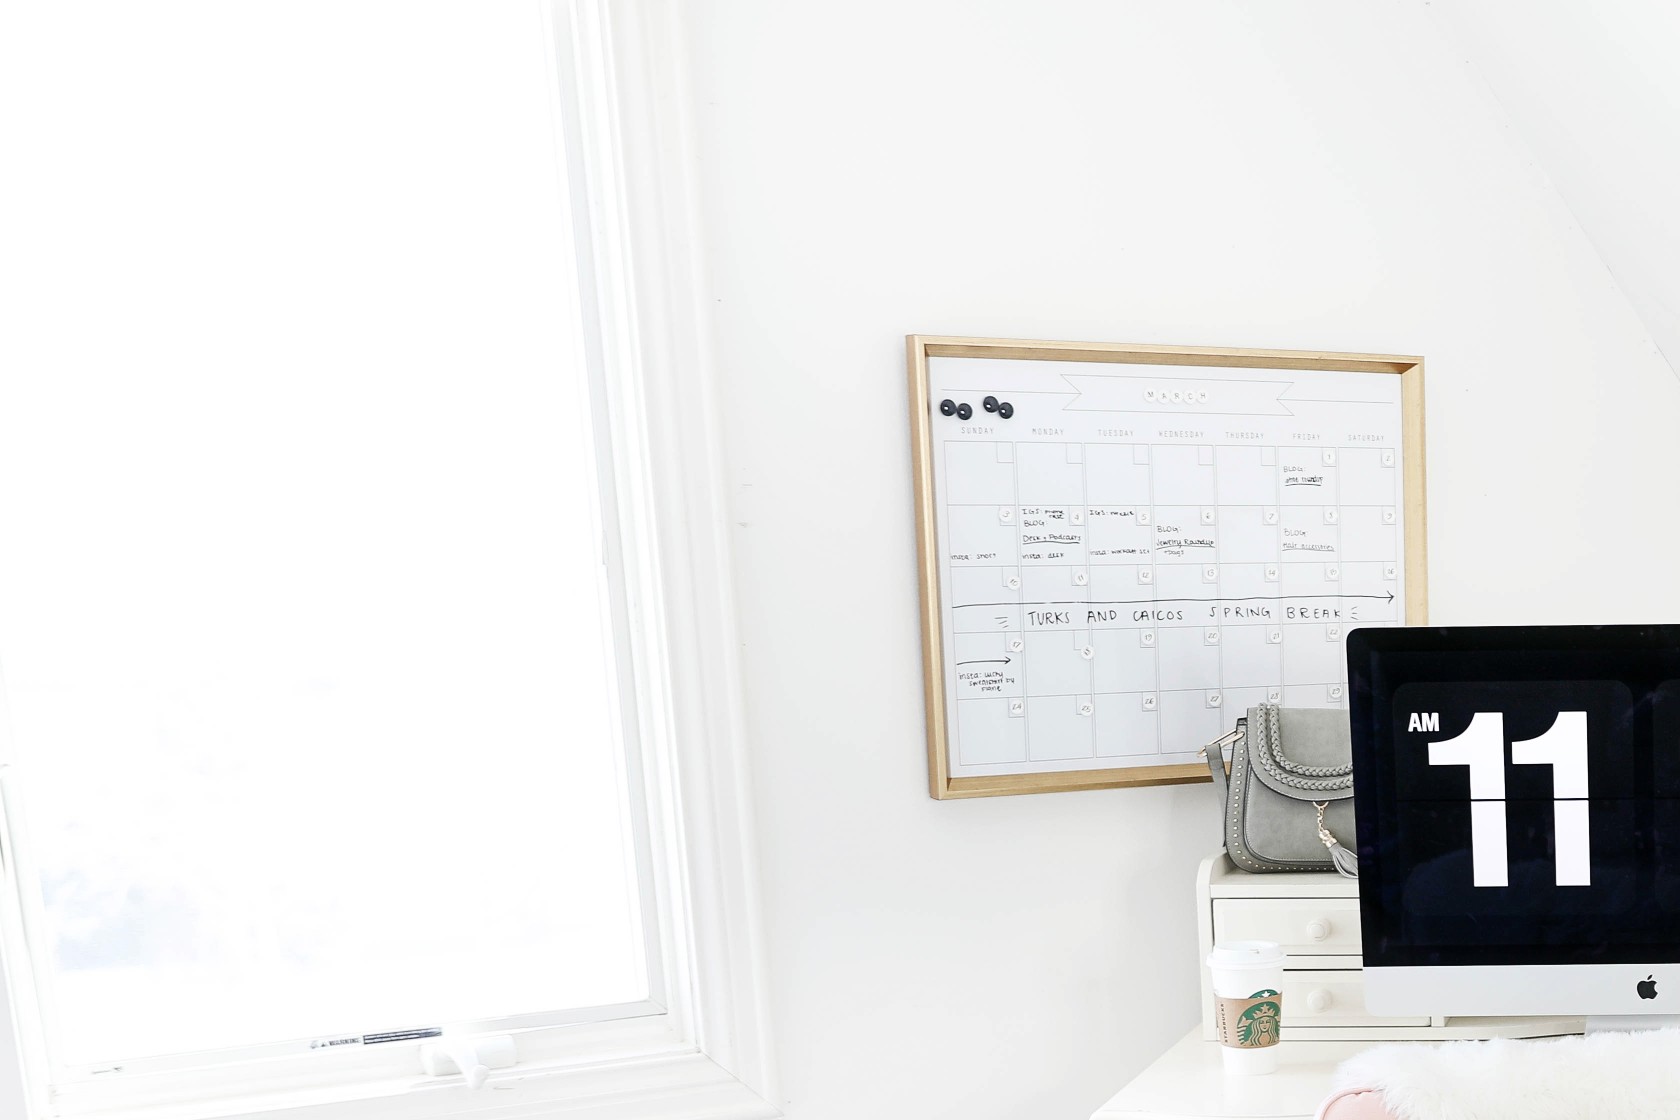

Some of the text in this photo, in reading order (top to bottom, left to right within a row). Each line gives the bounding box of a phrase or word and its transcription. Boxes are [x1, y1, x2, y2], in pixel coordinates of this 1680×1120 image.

[1147, 391, 1207, 400] MARCH
[961, 427, 995, 435] SUNDAY
[1032, 428, 1064, 436] MONDAY
[1098, 429, 1134, 438] TUESDAY
[1158, 430, 1204, 438] WEDNESDAY
[1225, 432, 1265, 440] THURSDAY
[1028, 606, 1341, 626] TURKS AND CAICOS SPRING BREAK
[1408, 712, 1440, 732] AM
[1428, 711, 1591, 887] 11
